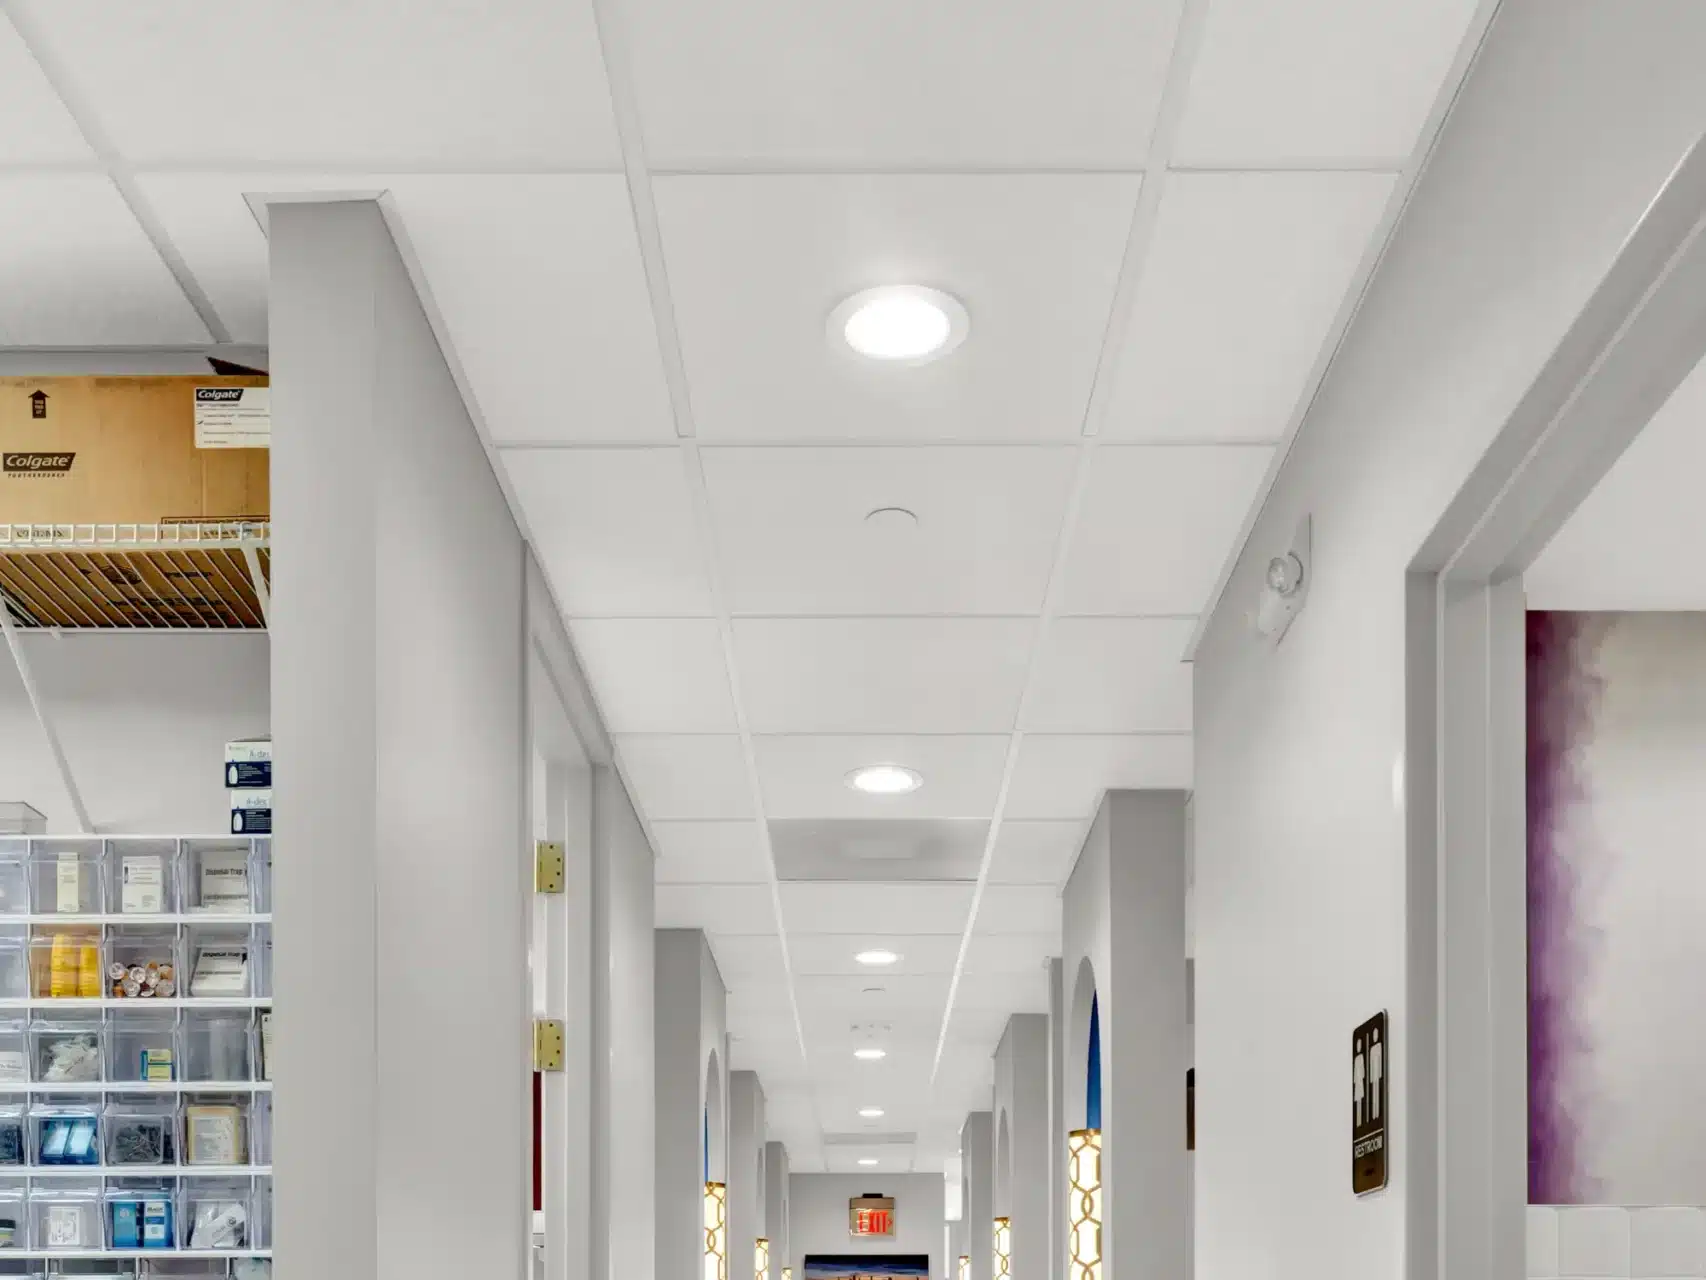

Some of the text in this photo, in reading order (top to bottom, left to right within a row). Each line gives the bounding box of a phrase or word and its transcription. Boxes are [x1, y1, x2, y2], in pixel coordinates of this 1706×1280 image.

[198, 390, 239, 401] Colgate
[6, 454, 70, 470] Colgate
[1354, 1135, 1383, 1159] RESTROOM
[857, 1210, 888, 1233] EXIT
